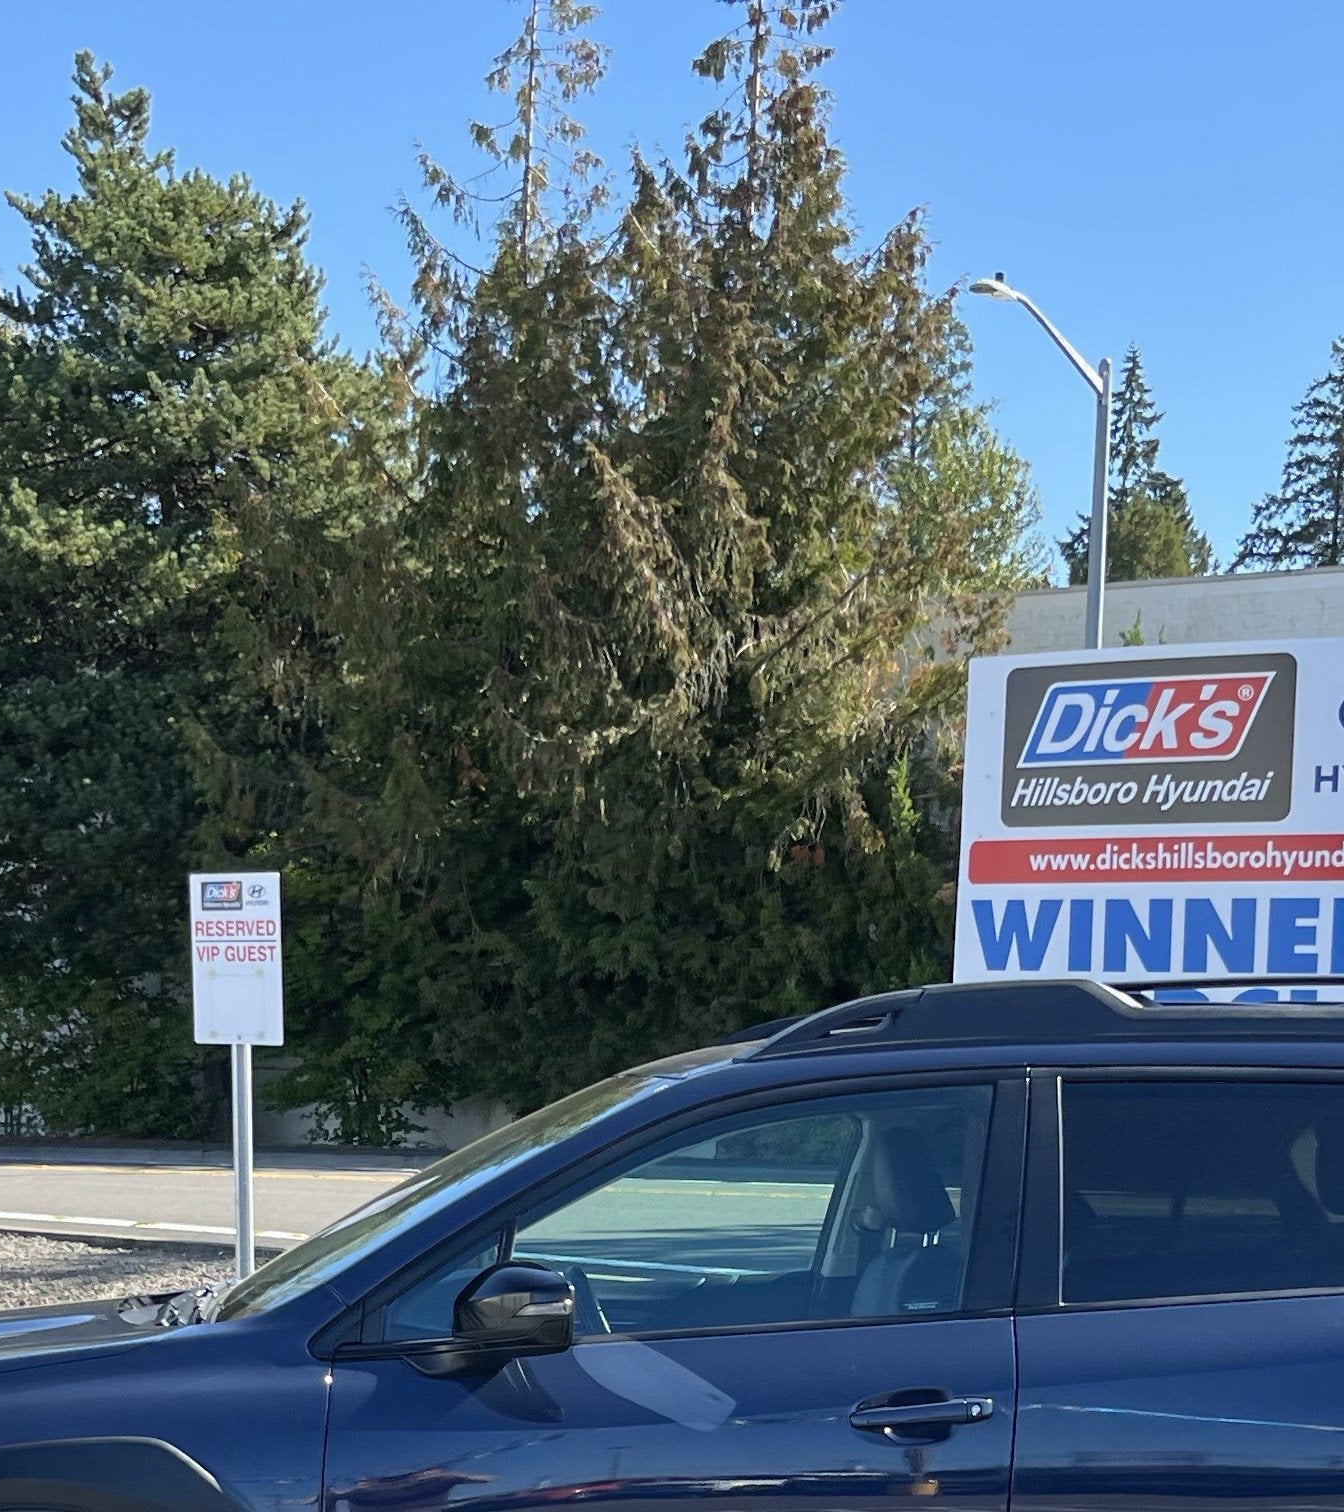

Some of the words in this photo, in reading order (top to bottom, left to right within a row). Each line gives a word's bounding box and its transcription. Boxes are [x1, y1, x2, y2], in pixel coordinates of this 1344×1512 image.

[1010, 776, 1138, 807] Hillsboro
[1142, 771, 1275, 811] Hyundai
[194, 920, 277, 937] RESERVED
[196, 946, 220, 962] VIP
[224, 946, 277, 962] GUEST
